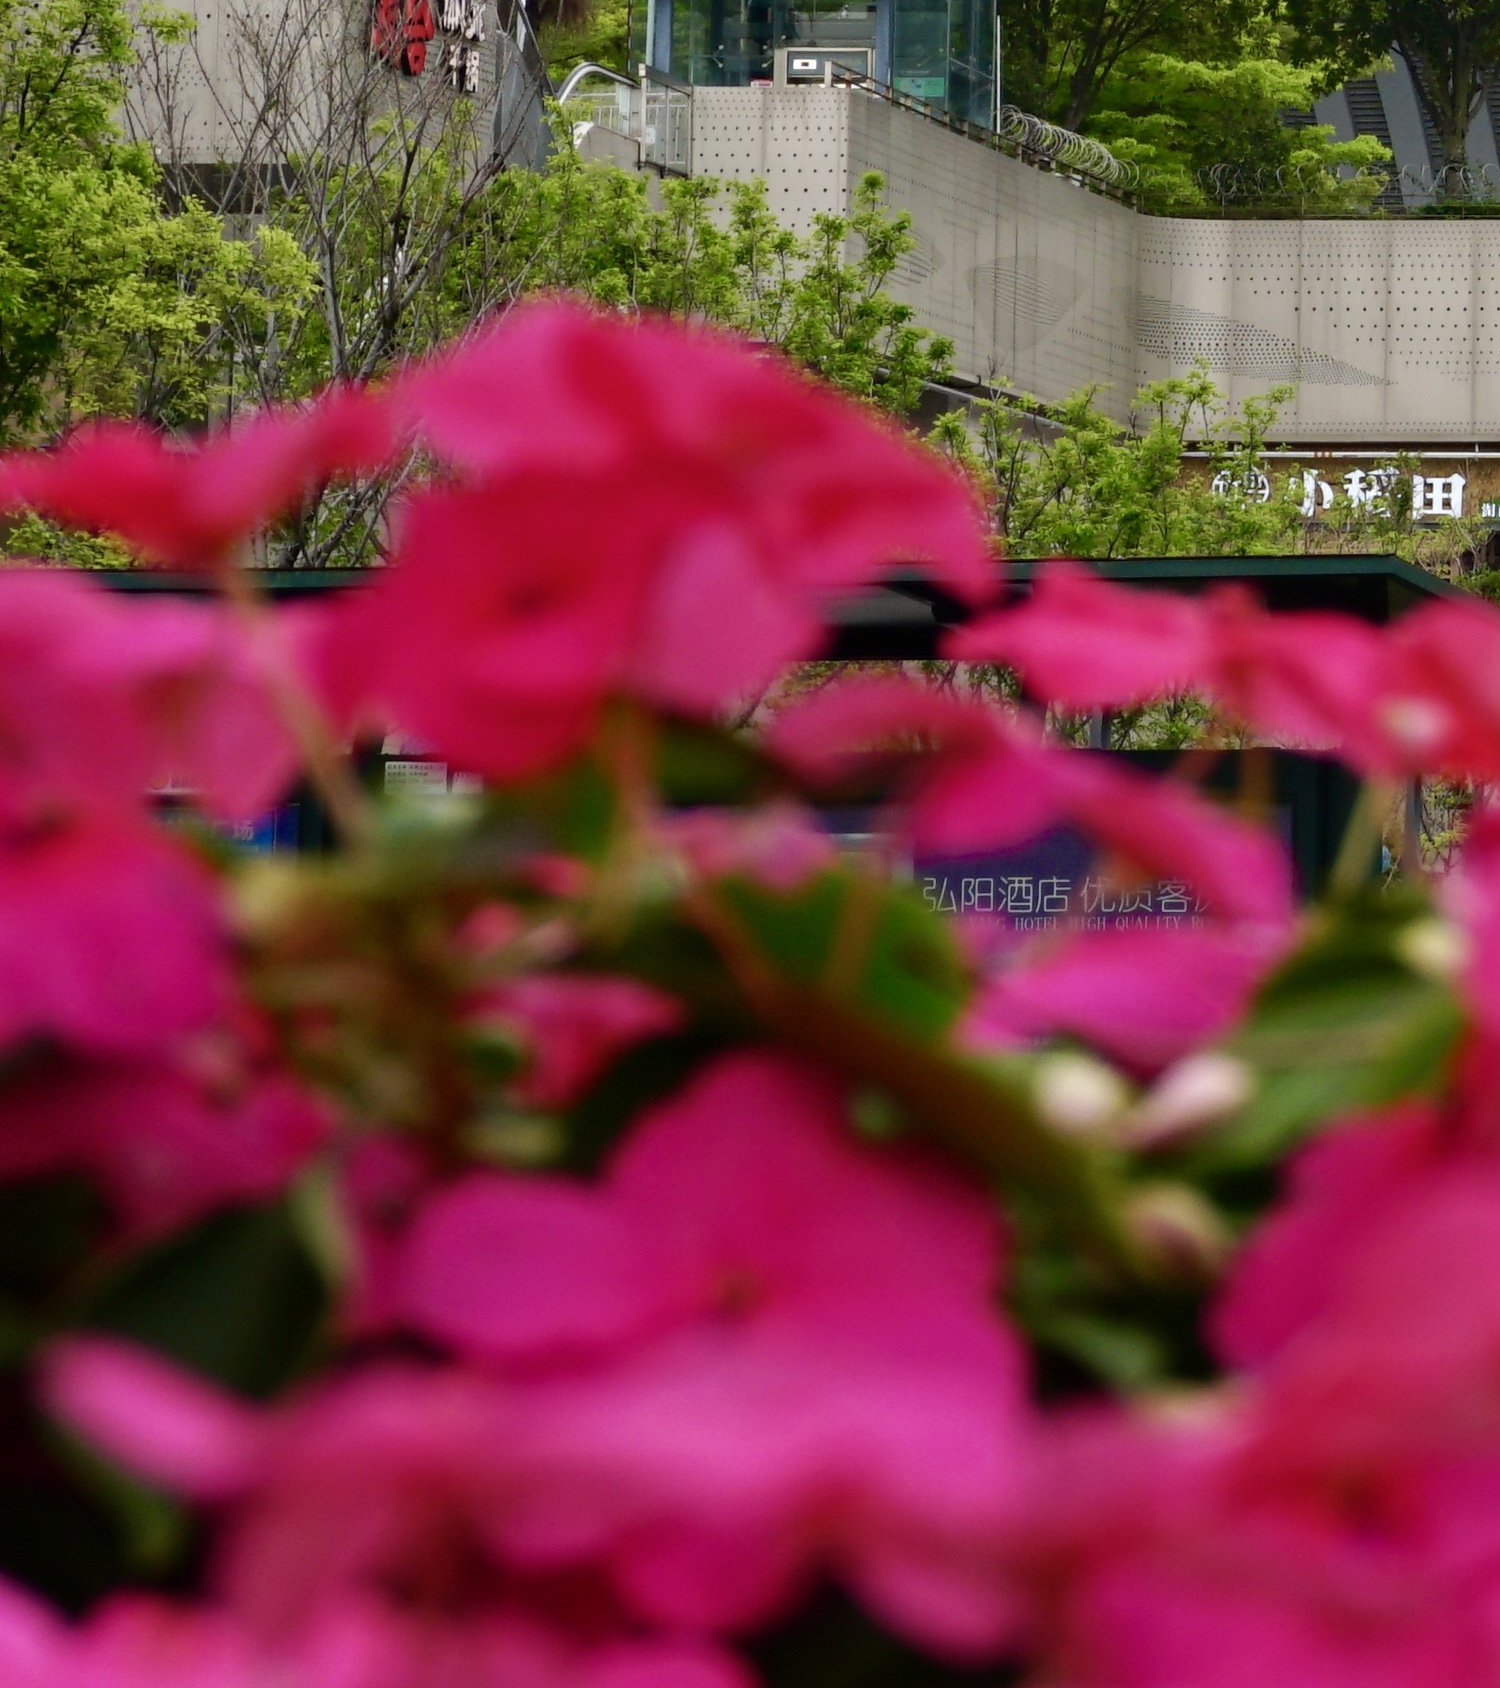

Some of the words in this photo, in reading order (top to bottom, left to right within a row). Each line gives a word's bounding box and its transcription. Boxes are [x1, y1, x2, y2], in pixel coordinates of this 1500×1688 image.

[923, 876, 1071, 913] 弘阳酒店
[1080, 876, 1208, 913] 优质客
